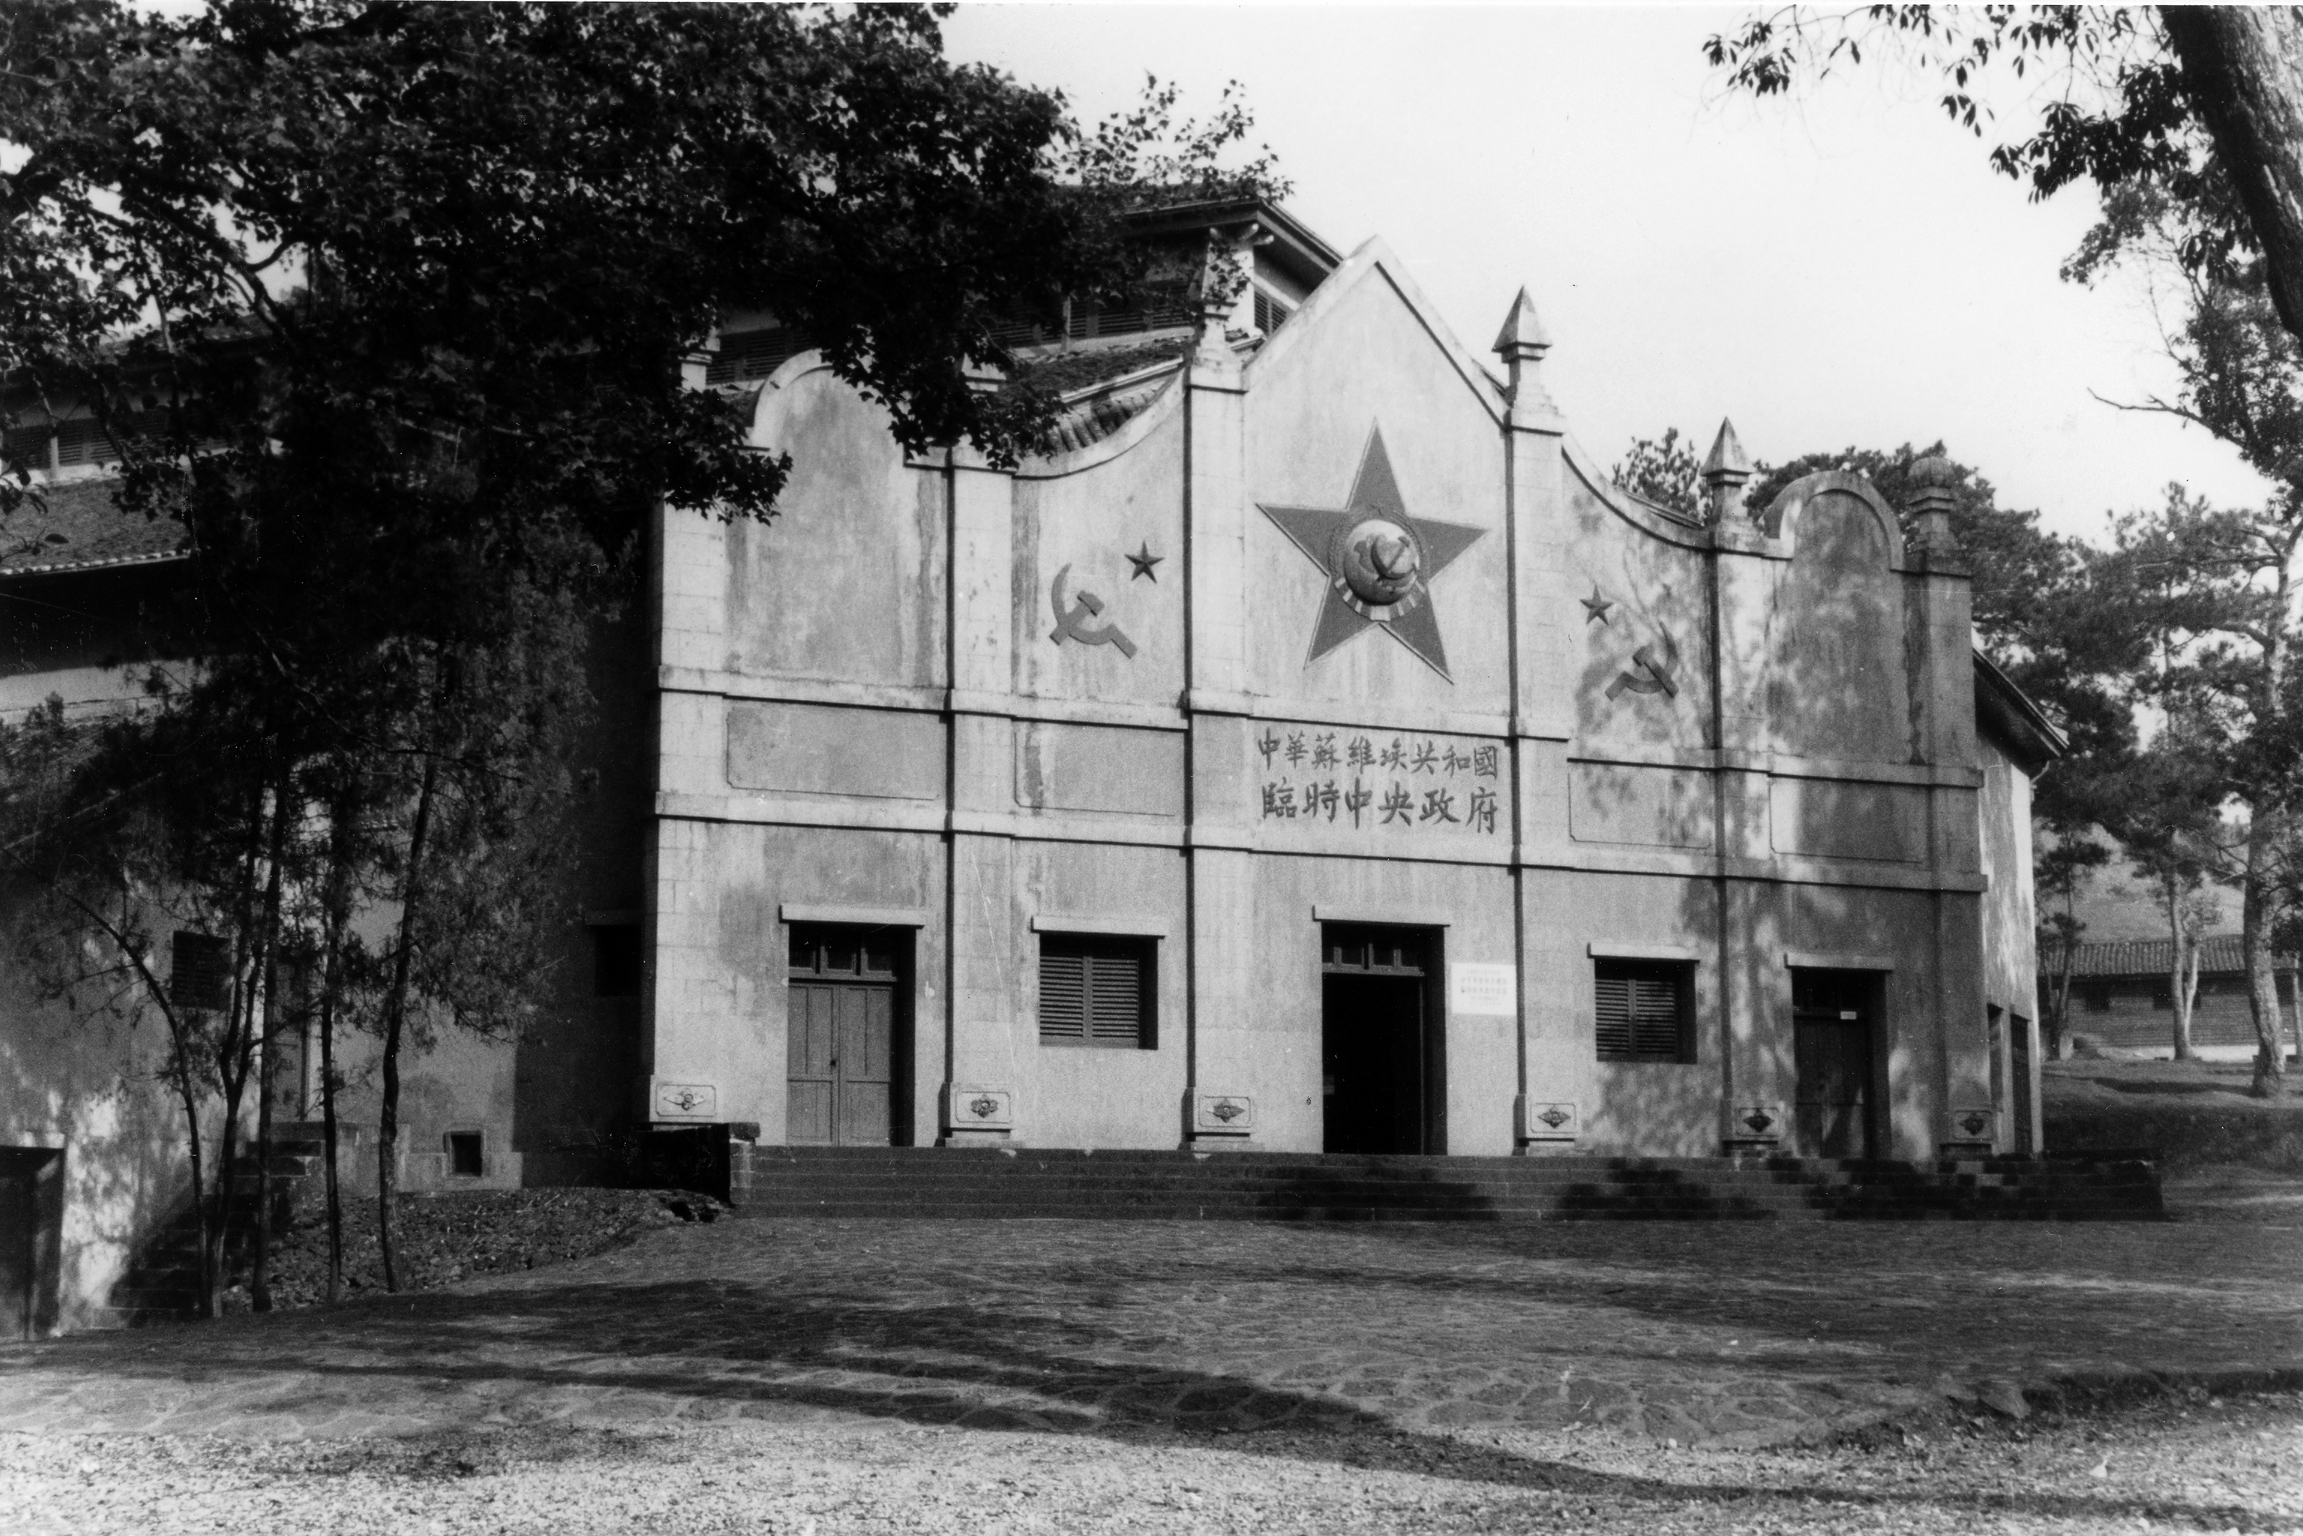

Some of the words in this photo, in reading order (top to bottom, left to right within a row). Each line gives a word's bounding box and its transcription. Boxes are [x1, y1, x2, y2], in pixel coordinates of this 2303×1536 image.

[1258, 727, 1498, 780] 中華蘇維埃共和國
[1261, 776, 1498, 834] 臨時中央政府
